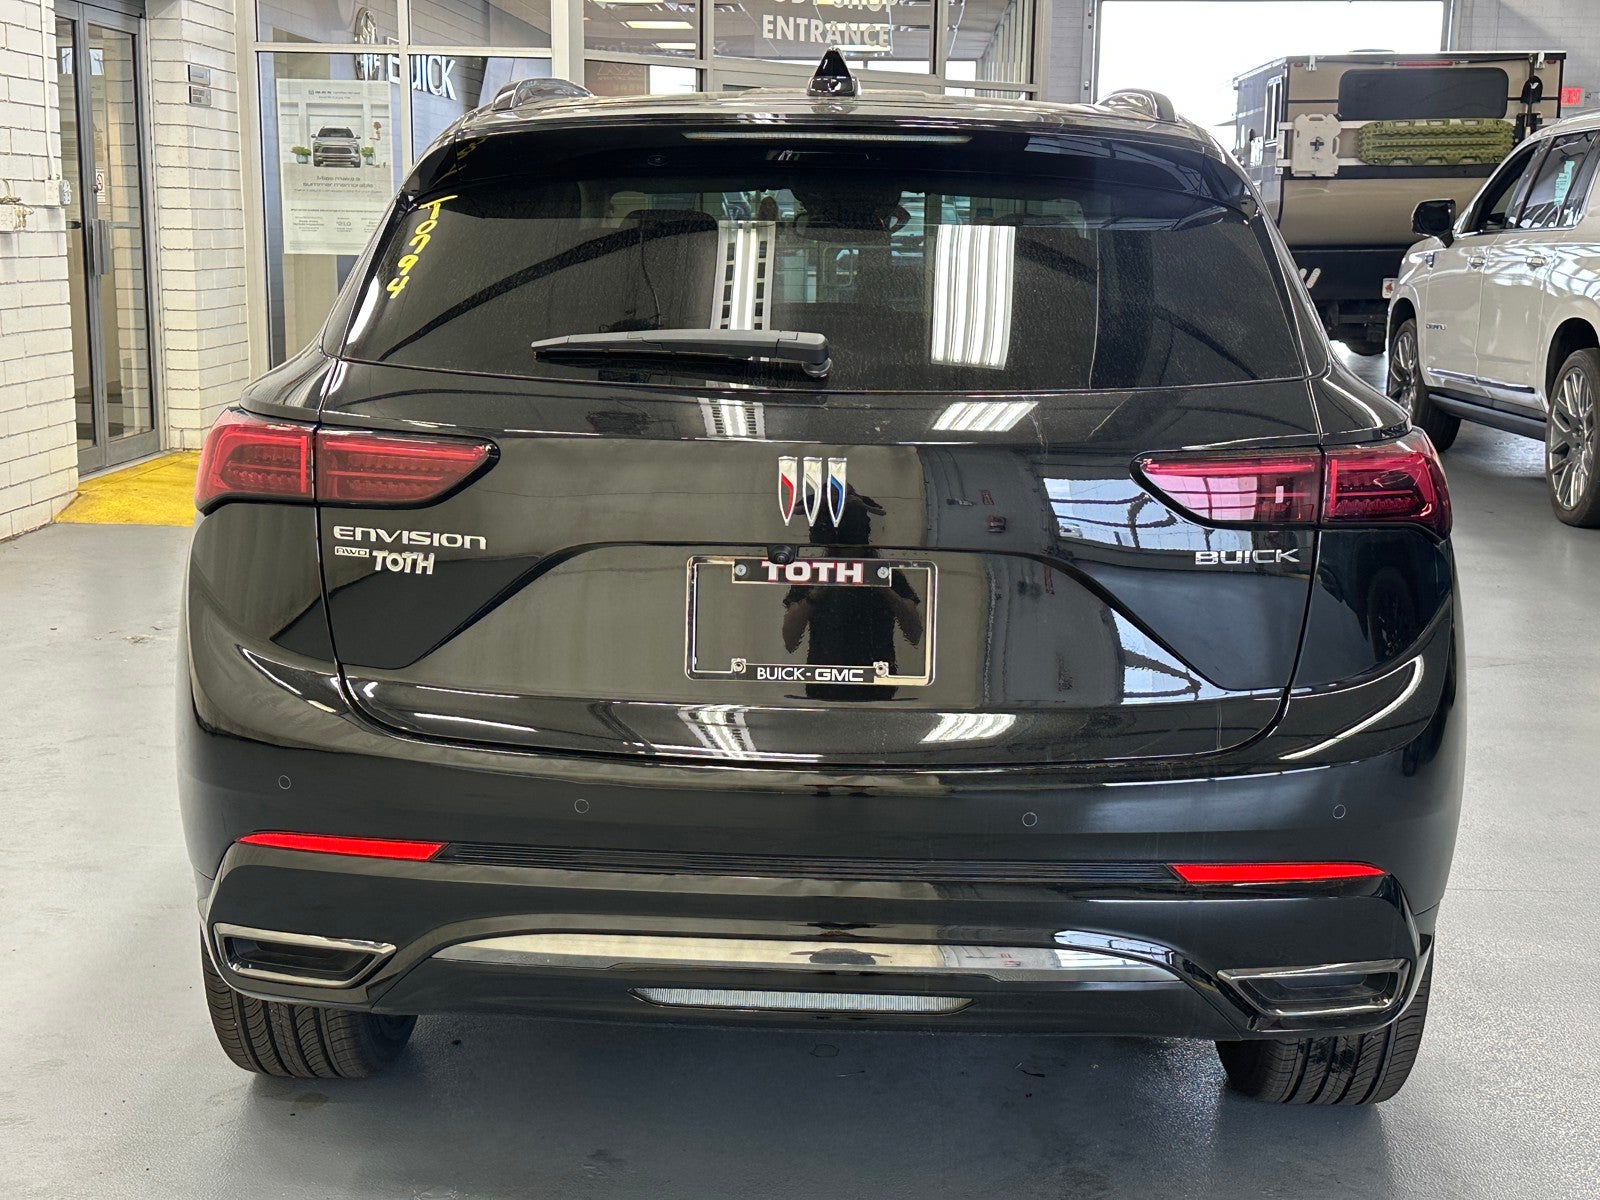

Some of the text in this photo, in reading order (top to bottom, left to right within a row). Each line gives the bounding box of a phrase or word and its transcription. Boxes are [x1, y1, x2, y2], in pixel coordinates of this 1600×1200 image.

[762, 14, 889, 47] ENTRANCE
[333, 525, 487, 550] ENVISION
[335, 547, 369, 557] AWD
[372, 550, 435, 575] TOTH
[1195, 548, 1300, 565] BUICK
[761, 560, 864, 584] TOTH
